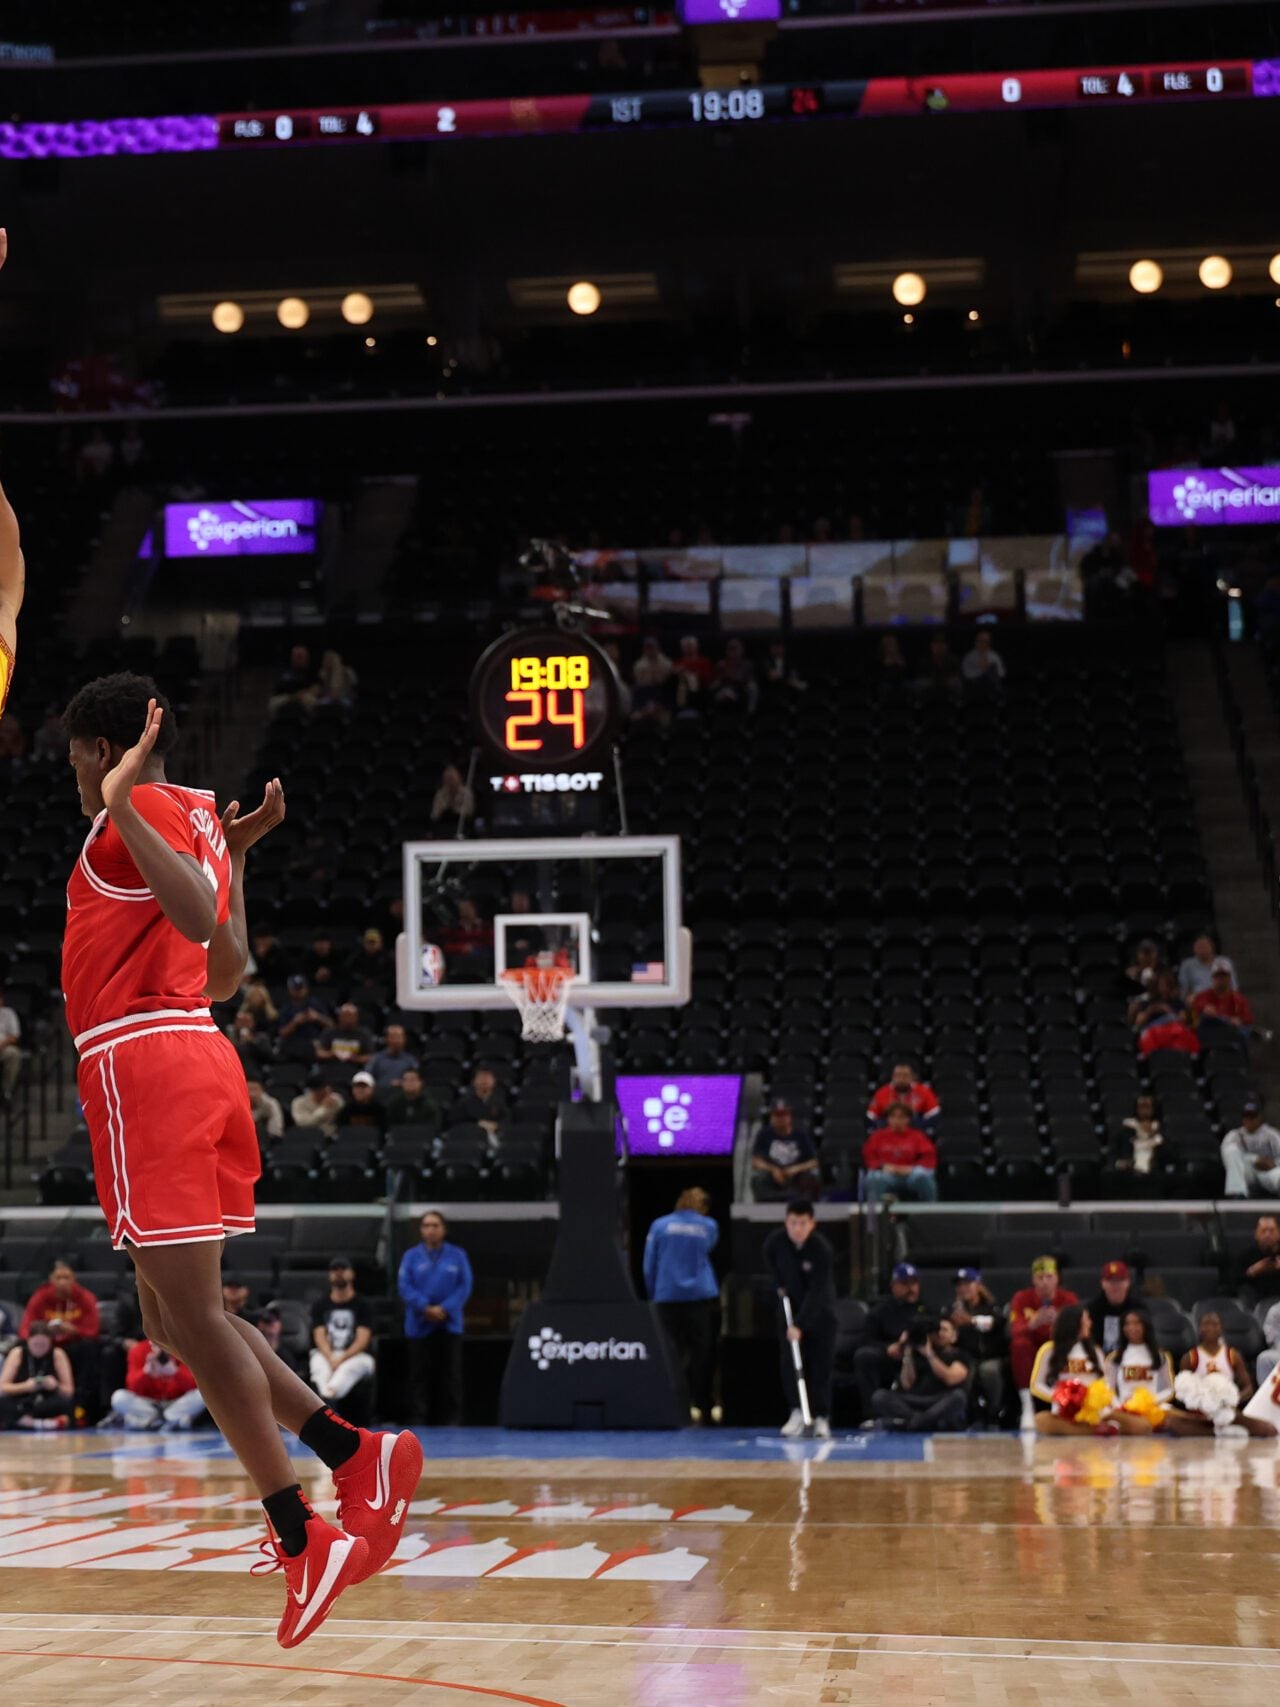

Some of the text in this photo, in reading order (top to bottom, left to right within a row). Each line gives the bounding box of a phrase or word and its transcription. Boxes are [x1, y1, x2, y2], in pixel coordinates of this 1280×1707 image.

[1003, 78, 1021, 102] 0
[1117, 72, 1133, 96] 4
[1206, 68, 1223, 92] 0
[689, 88, 764, 121] 19:08
[275, 115, 293, 140] 0
[356, 111, 374, 136] 4
[437, 107, 456, 132] 2
[199, 514, 299, 545] experian
[511, 656, 590, 691] 19:08
[505, 690, 586, 750] 24
[519, 772, 604, 793] TISSOT
[541, 1337, 646, 1365] experian
